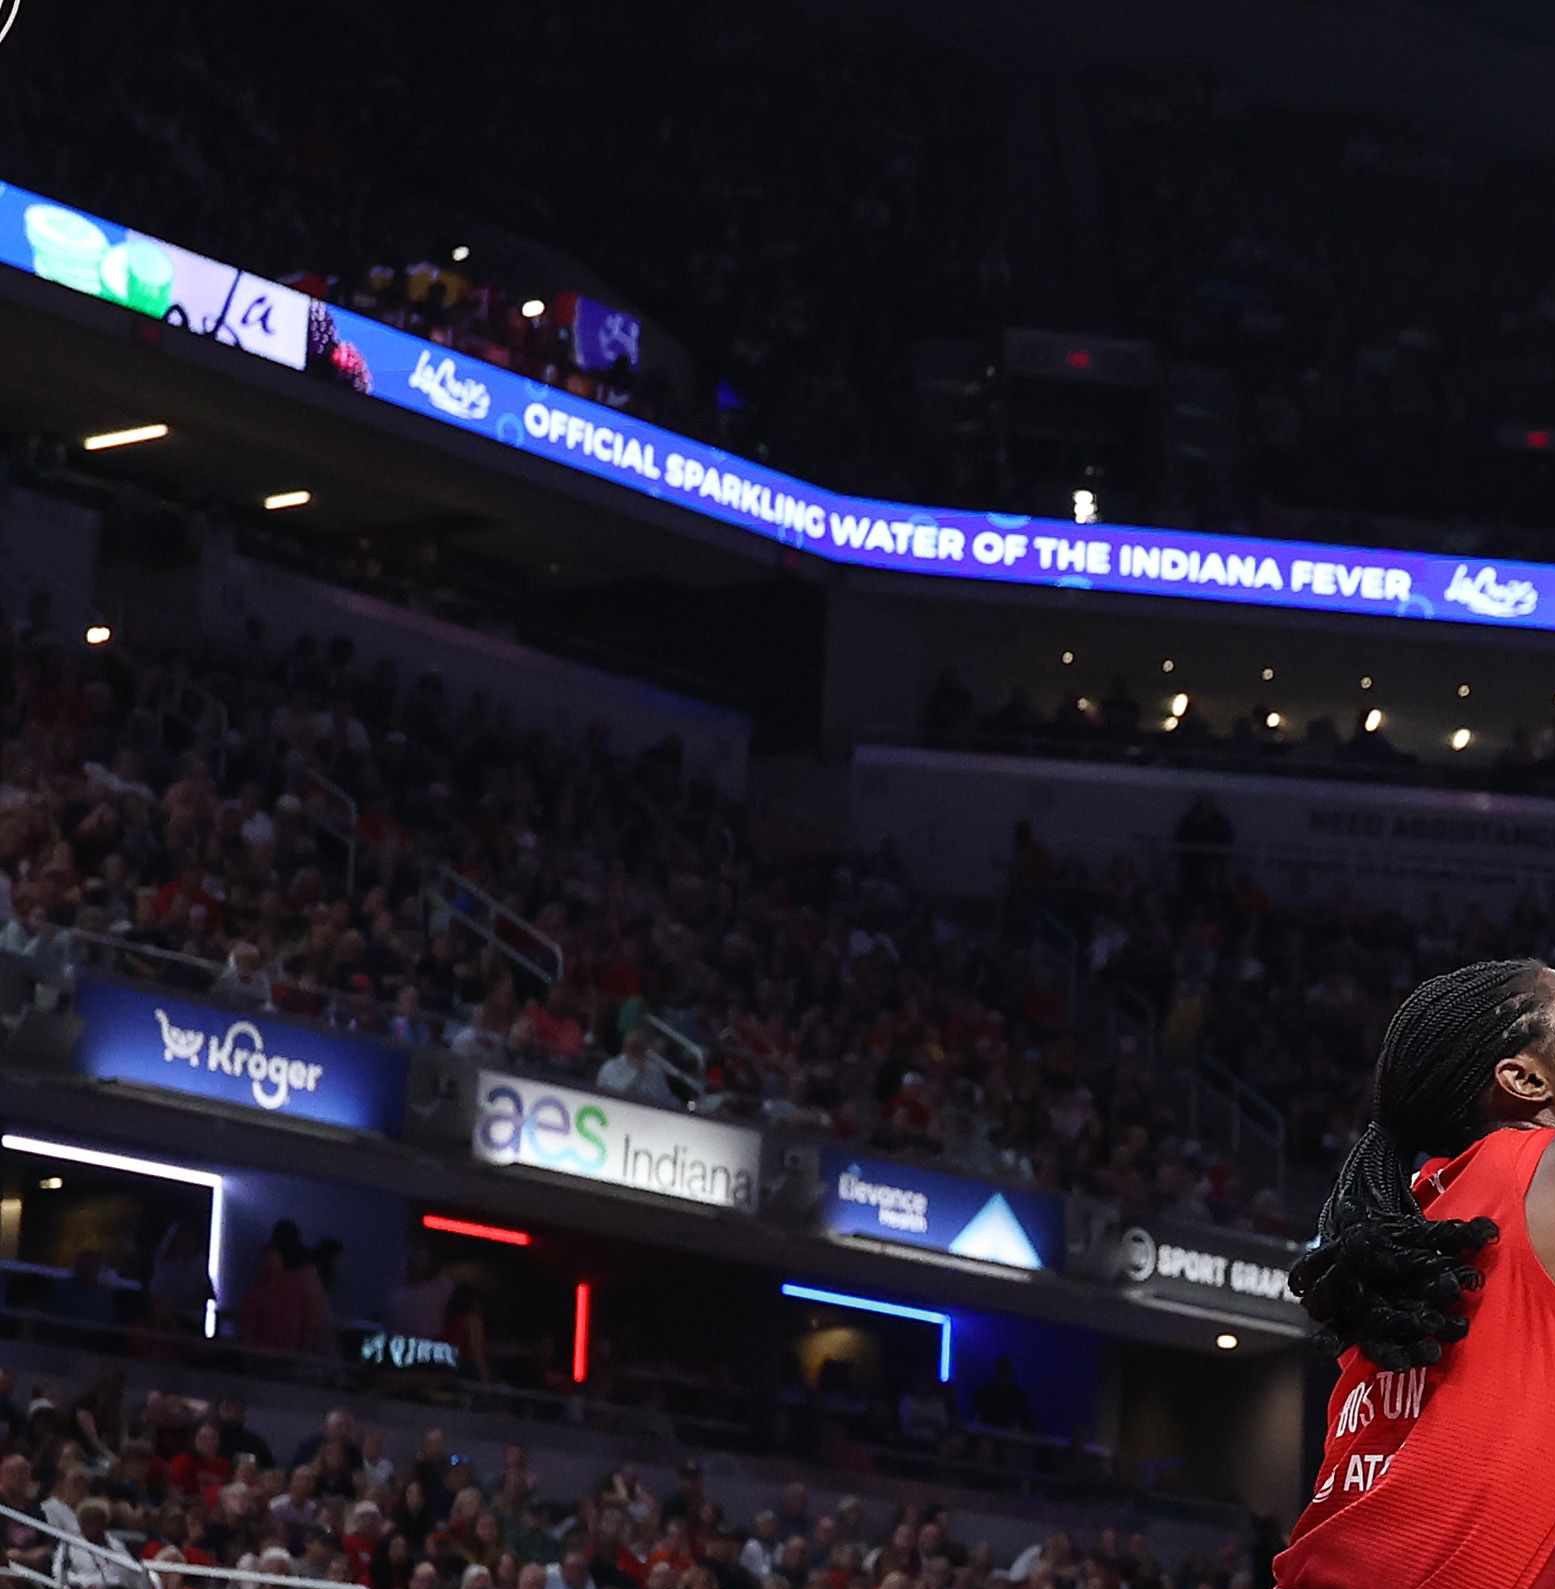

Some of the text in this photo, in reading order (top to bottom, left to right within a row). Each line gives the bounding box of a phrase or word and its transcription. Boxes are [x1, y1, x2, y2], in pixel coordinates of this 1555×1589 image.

[523, 402, 1412, 602] OFFICIAL SPARKLING WATER OF THE INDIANA FEVER
[207, 1020, 323, 1110] Kroger
[480, 1086, 753, 1205] aes Indiana
[1157, 1244, 1229, 1287] SPORT
[1343, 1453, 1397, 1493] AT
